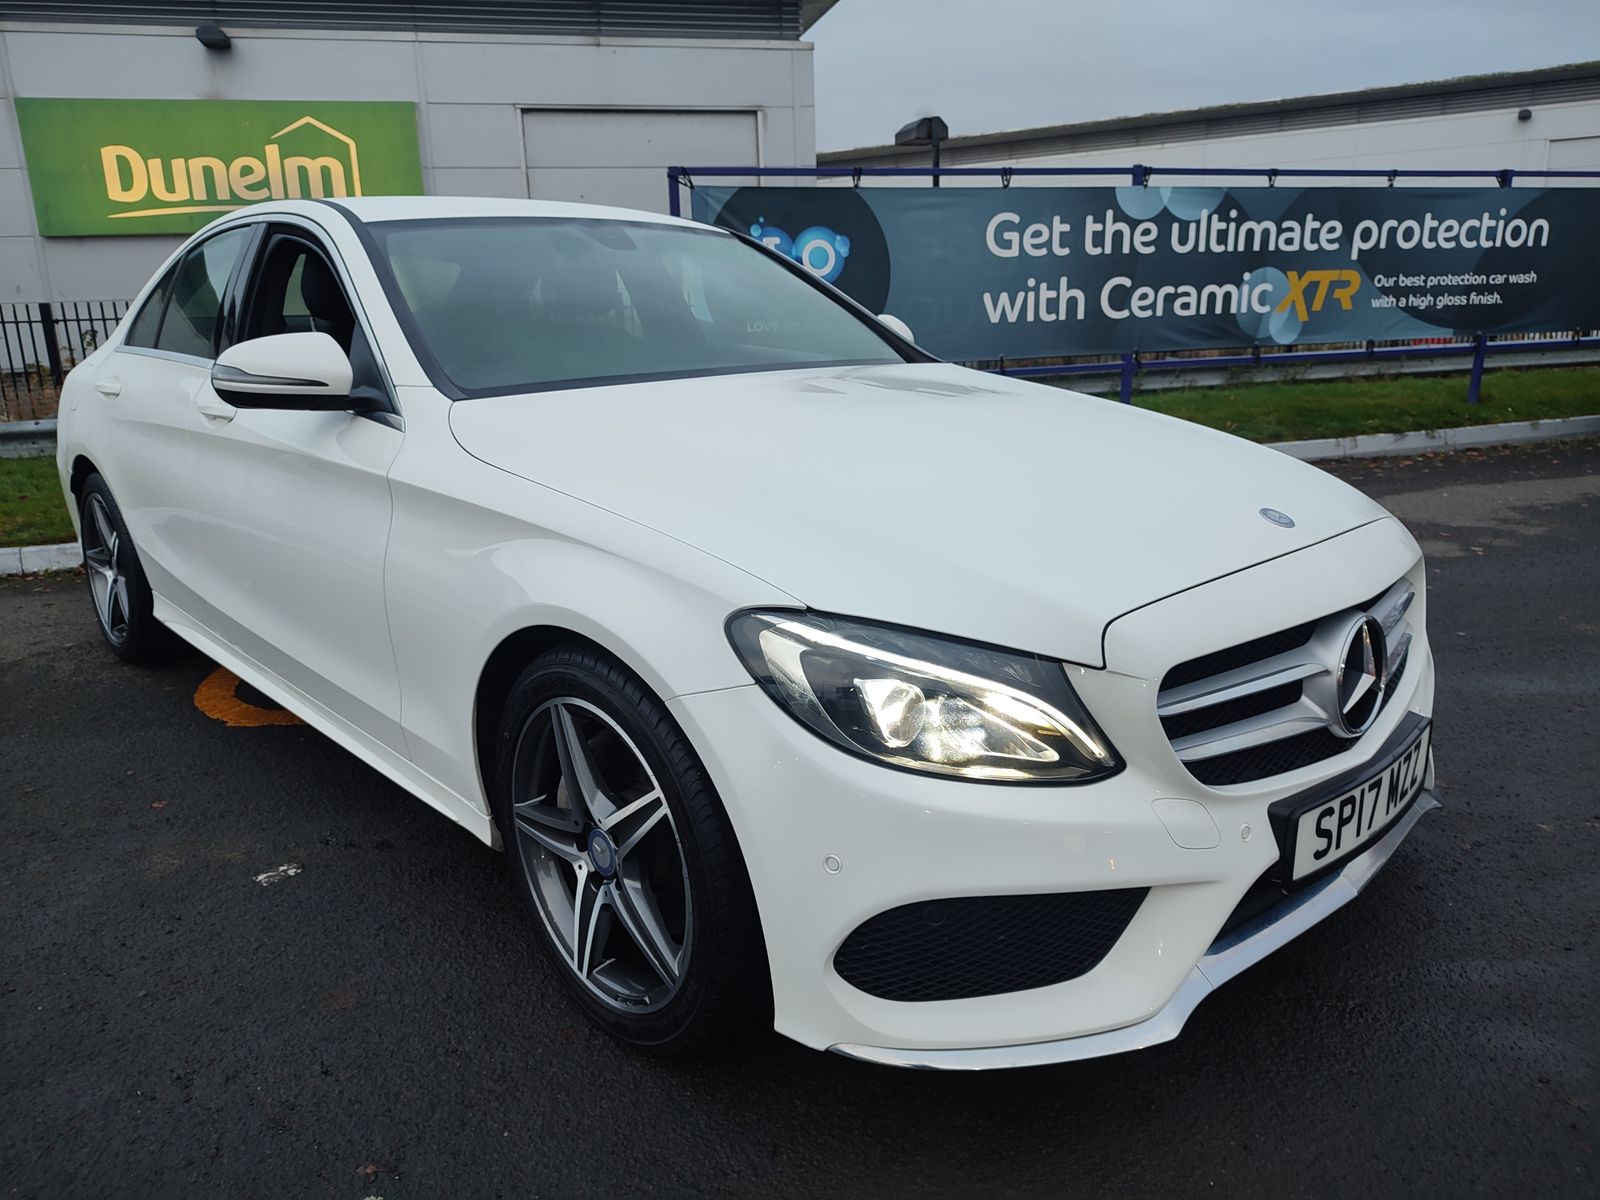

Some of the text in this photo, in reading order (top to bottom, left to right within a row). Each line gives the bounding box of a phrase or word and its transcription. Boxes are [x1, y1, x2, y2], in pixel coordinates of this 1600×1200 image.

[100, 143, 347, 202] Dunelm
[985, 207, 1550, 261] Get the ultimate protection
[982, 268, 1362, 324] with Ceramic XTR
[1371, 291, 1503, 310] with a high gloss finish.
[1374, 270, 1537, 288] Our best protection car wash
[1313, 738, 1422, 861] SP17 MZZ
